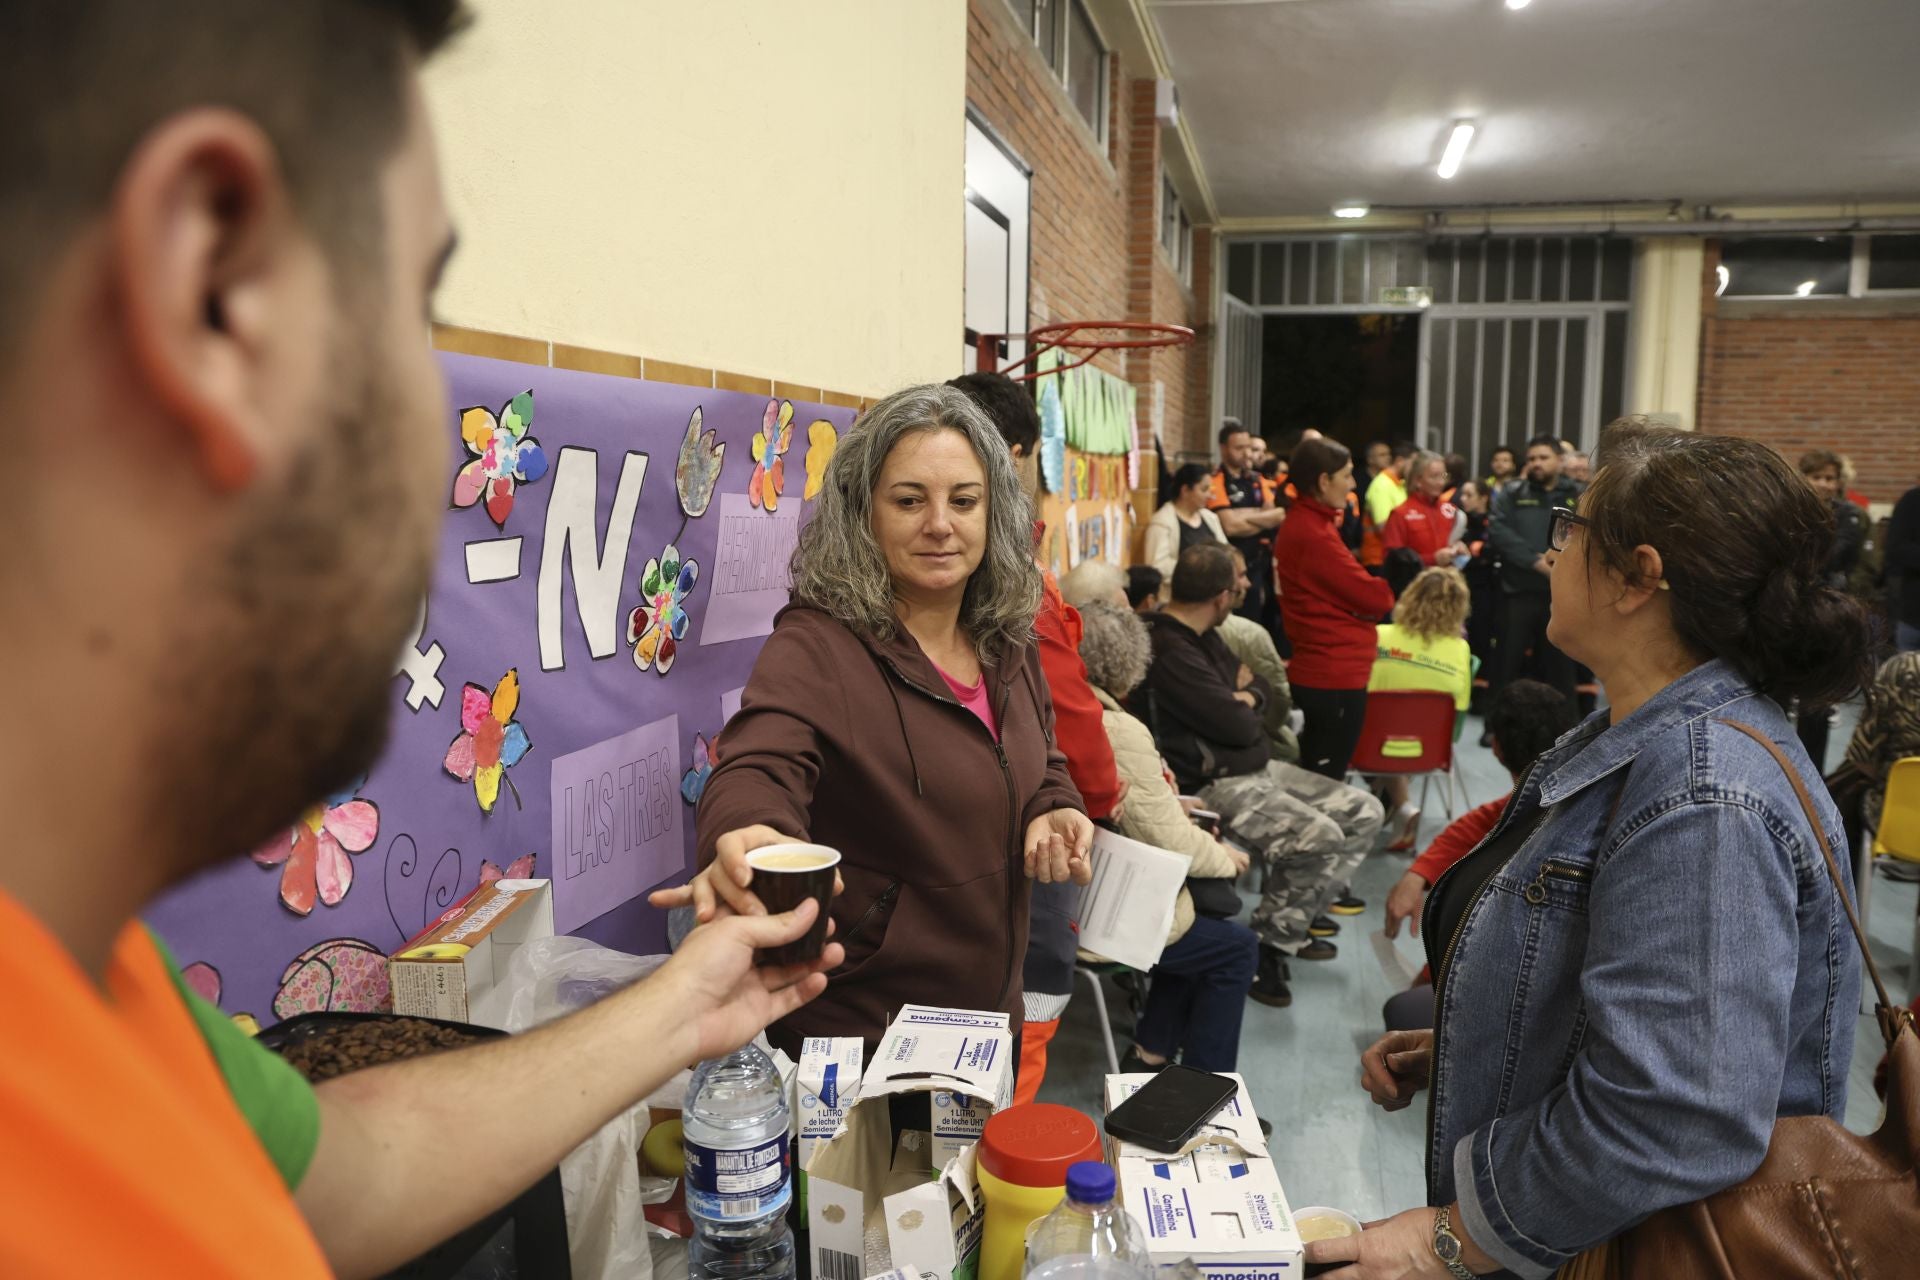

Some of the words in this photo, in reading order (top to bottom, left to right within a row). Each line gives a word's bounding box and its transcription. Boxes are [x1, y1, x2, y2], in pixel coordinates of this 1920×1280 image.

[564, 771, 615, 880] LAS
[618, 746, 673, 852] TRES
[909, 1014, 980, 1025] Campesina
[894, 1037, 912, 1061] ASTURIAS
[966, 1042, 983, 1067] Campesina
[816, 1109, 821, 1118] 1
[822, 1109, 843, 1118] LITRO
[950, 1109, 955, 1118] 1
[955, 1109, 976, 1118] LITRO
[808, 1118, 818, 1126] de
[818, 1118, 836, 1127] leche
[941, 1118, 950, 1126] de
[951, 1118, 969, 1127] leche
[969, 1118, 984, 1127] UHT
[1161, 1194, 1179, 1232] Campesina
[1174, 1207, 1186, 1217] La
[1253, 1194, 1275, 1231] ASTURIAS
